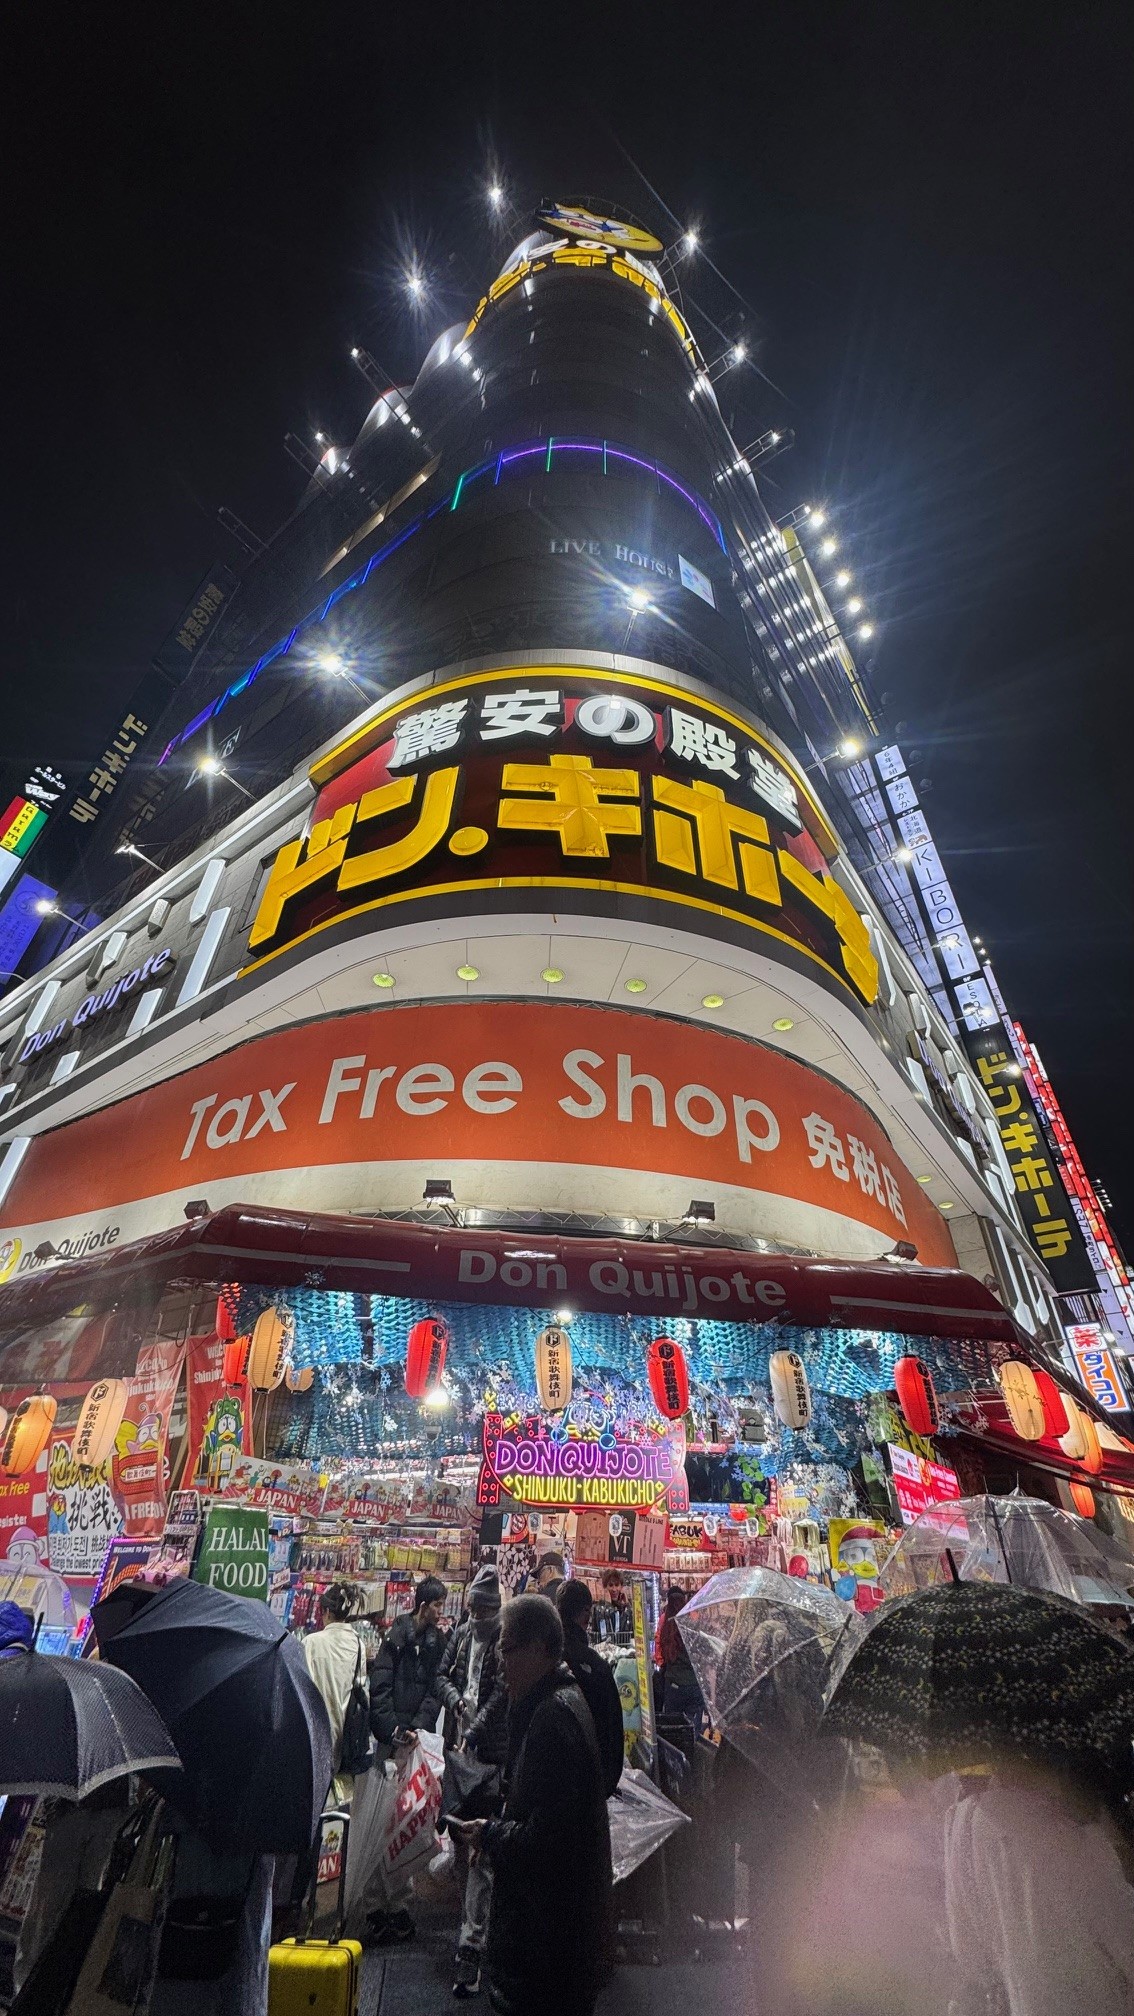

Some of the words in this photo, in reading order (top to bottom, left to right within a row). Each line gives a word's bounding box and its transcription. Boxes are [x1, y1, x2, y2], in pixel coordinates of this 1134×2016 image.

[550, 540, 601, 555] LIVE
[615, 544, 675, 579] HOUSE
[393, 689, 803, 831] 驚安の殿堂
[894, 782, 910, 809] おかか
[915, 848, 964, 970] KIBORI
[19, 1018, 68, 1063] Don
[72, 948, 172, 1027] Quijote
[180, 1081, 298, 1161] Tax
[318, 1054, 524, 1124] Free
[558, 1048, 780, 1164] Shop
[801, 1111, 910, 1231] 免税店
[457, 1250, 568, 1290] Don
[589, 1259, 787, 1310] Quijote
[548, 1349, 561, 1399] 新宿歌舞伎町
[76, 1403, 101, 1456] 新宿歌舞伎町
[495, 1440, 555, 1475] DON
[559, 1442, 673, 1480] QUIJOTE
[257, 1489, 297, 1509] JAPAN
[351, 1500, 385, 1518] JAPAN
[0, 1515, 27, 1528] gister
[613, 1535, 631, 1554] VT
[208, 1562, 267, 1588] FOOD
